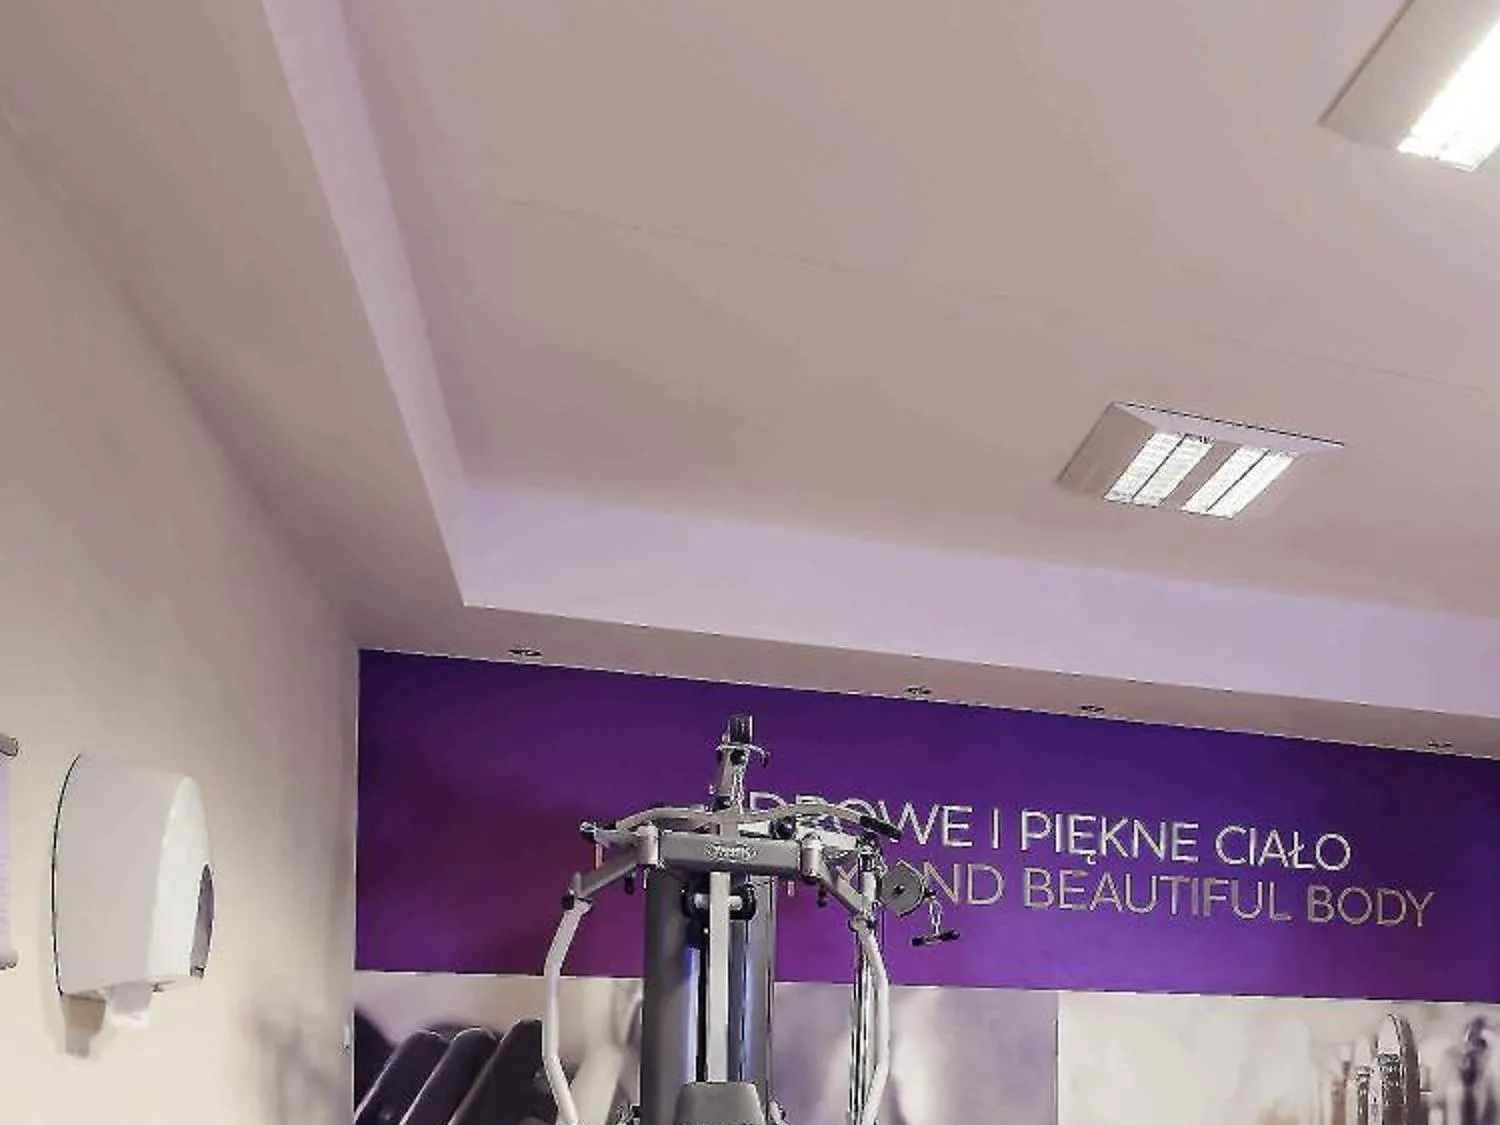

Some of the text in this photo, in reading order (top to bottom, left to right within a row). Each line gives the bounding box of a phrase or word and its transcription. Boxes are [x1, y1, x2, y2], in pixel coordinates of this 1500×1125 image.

[991, 807, 1000, 849] I
[1020, 808, 1200, 866] PIĘKNE
[1214, 824, 1352, 872] CIAŁO
[1023, 866, 1293, 921] BEAUTIFUL
[1306, 883, 1435, 928] BODY
